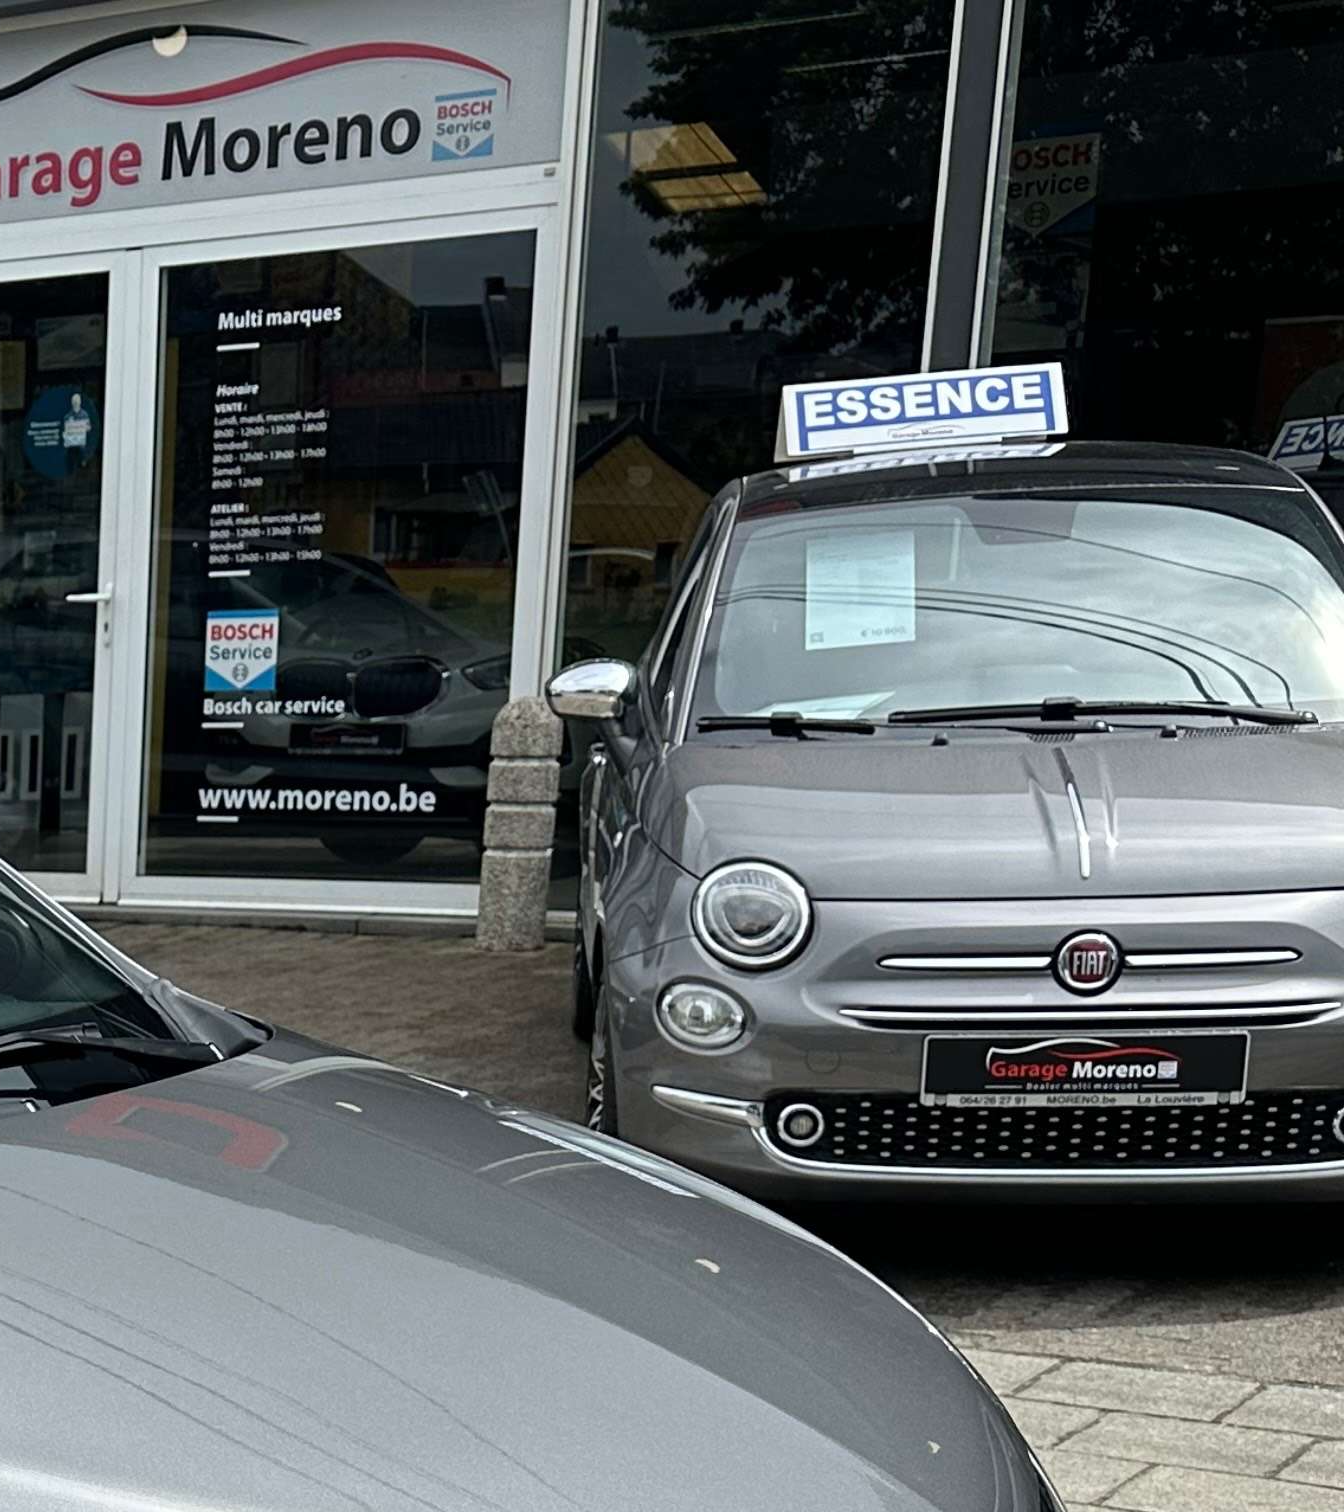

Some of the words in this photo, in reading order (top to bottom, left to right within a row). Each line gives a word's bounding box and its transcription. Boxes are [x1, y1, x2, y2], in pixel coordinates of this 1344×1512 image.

[436, 101, 493, 121] BOSCH
[436, 118, 493, 138] Service
[161, 107, 422, 181] Moreno
[218, 310, 263, 330] Multi
[267, 306, 342, 329] marques
[216, 382, 259, 397] Horaire
[803, 374, 1045, 428] ESSENCE
[210, 623, 274, 641] BOSCH
[209, 643, 273, 662] Service
[203, 697, 252, 716] Bosch
[255, 701, 282, 715] car
[285, 697, 345, 715] service
[199, 783, 436, 813] www.moreno.be
[1072, 951, 1107, 975] FIAT
[991, 1061, 1068, 1081] Garage
[1072, 1061, 1156, 1080] Moreno
